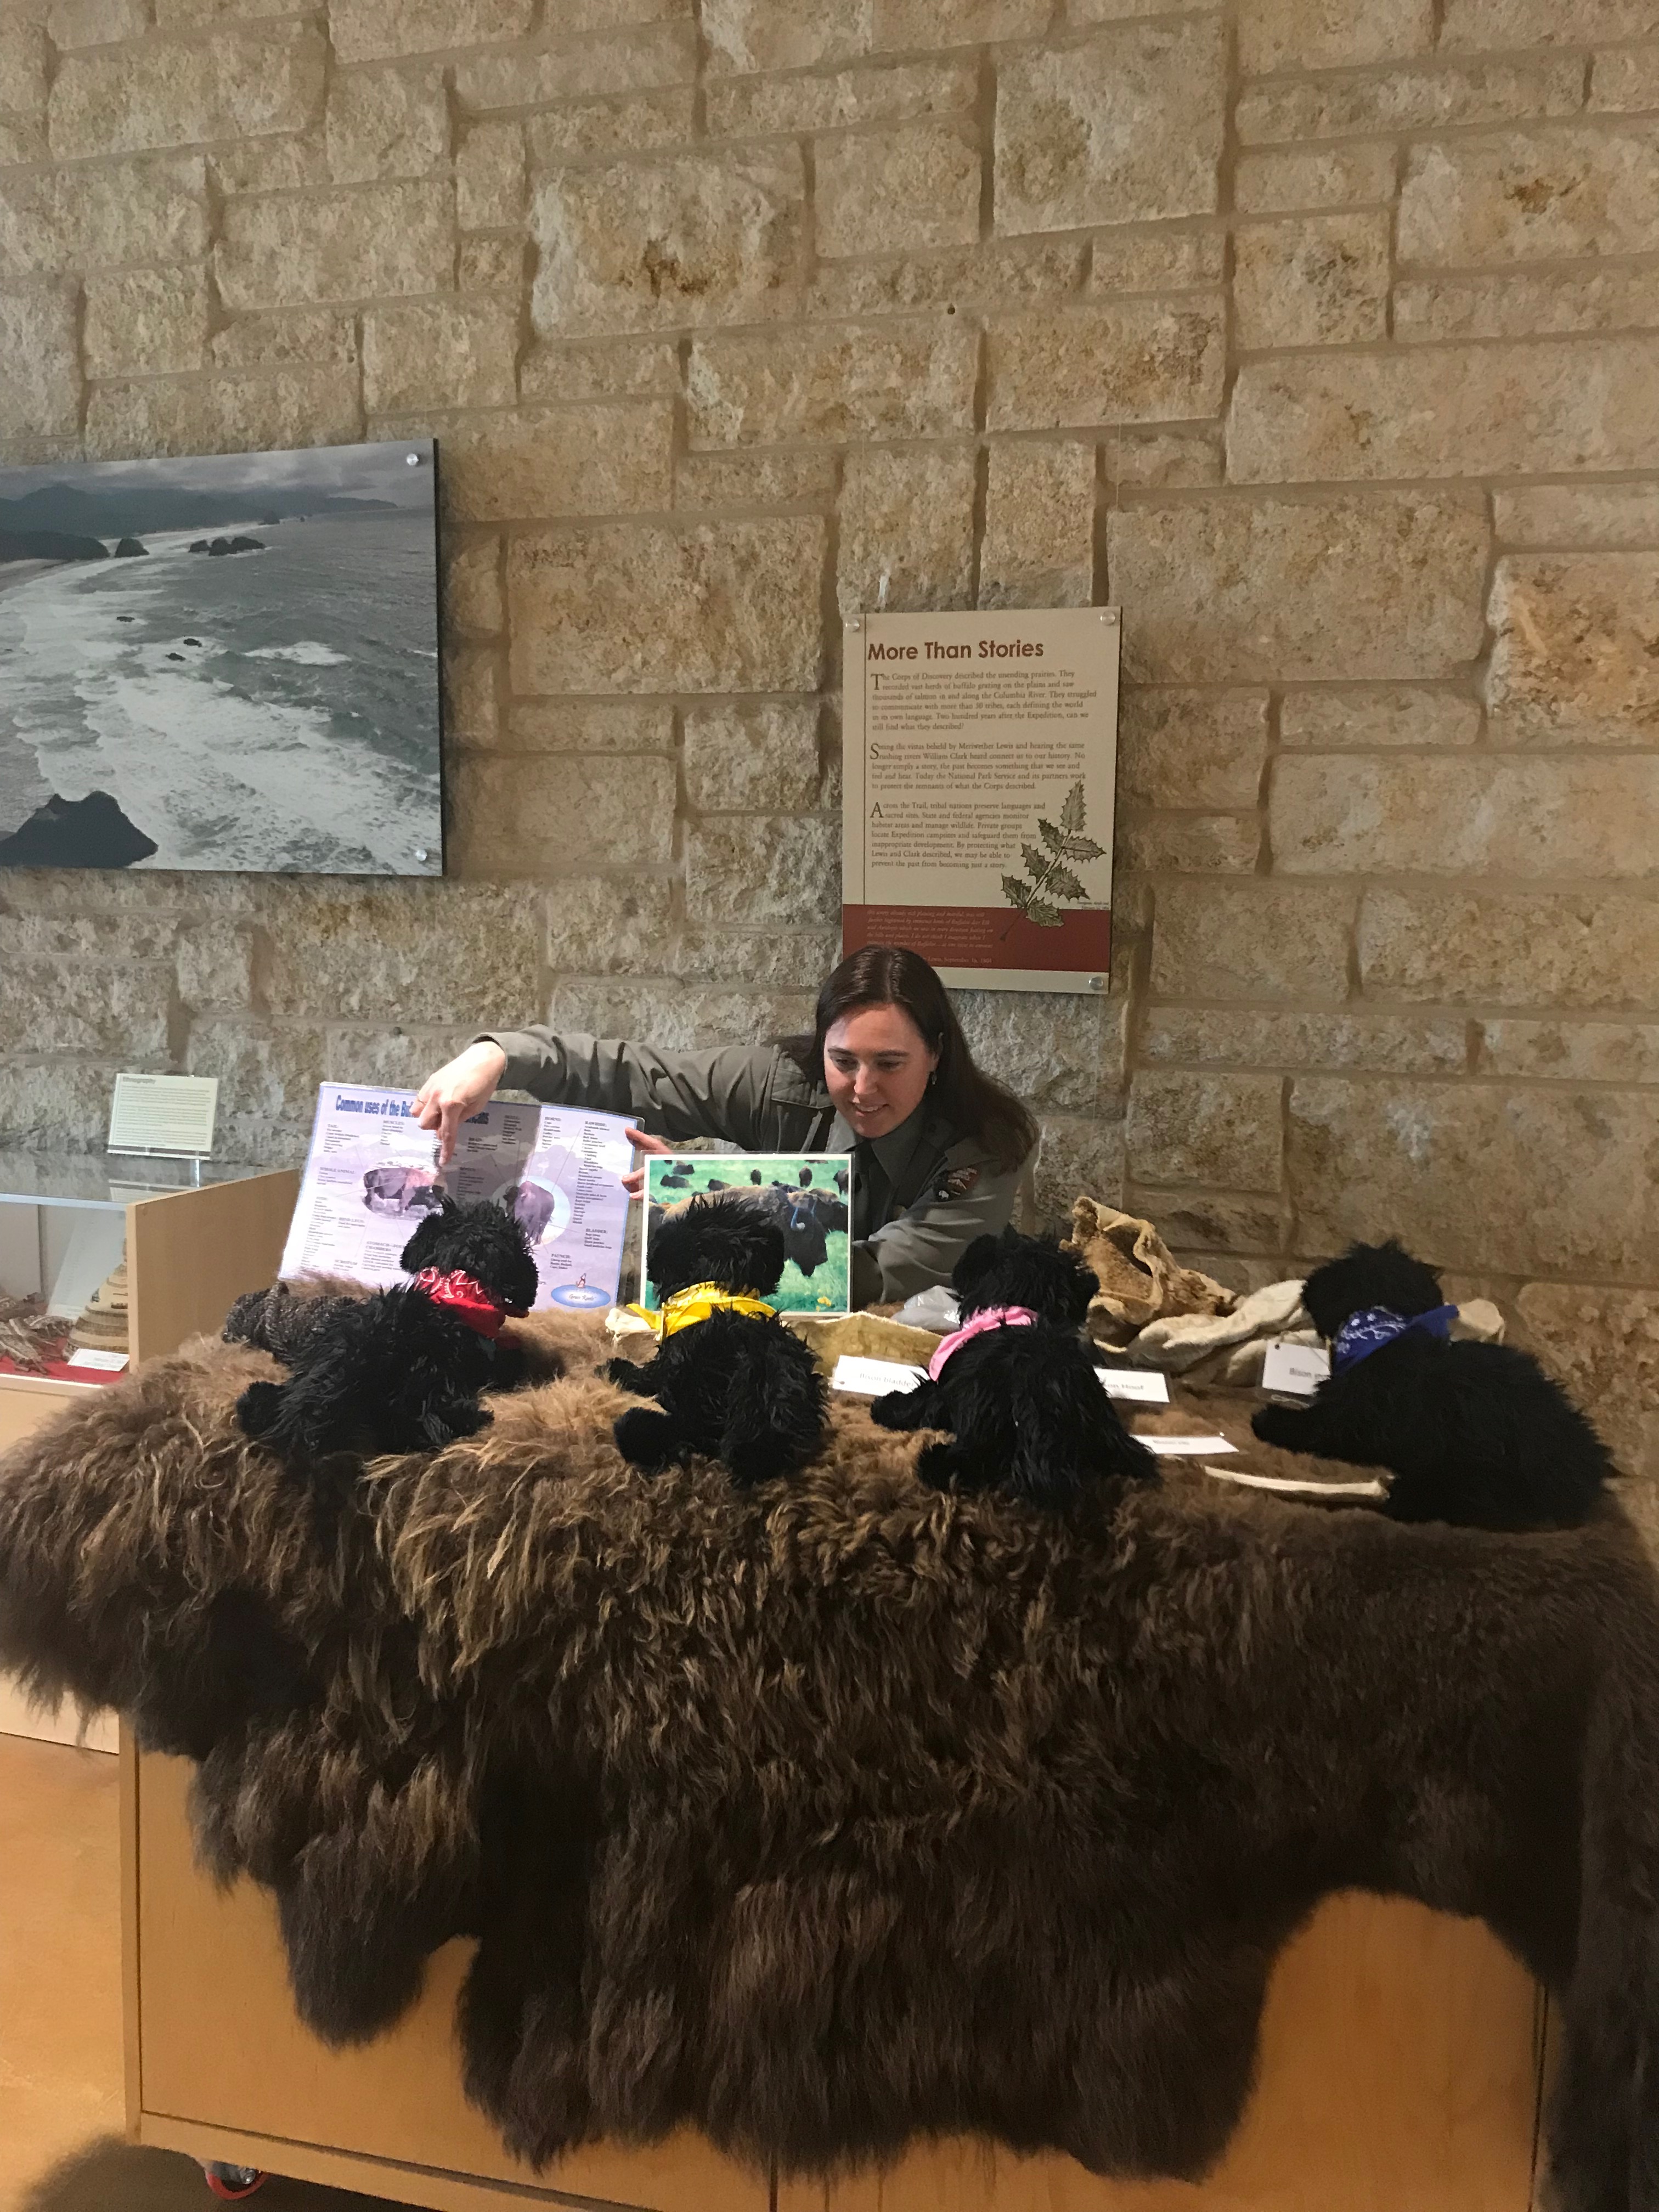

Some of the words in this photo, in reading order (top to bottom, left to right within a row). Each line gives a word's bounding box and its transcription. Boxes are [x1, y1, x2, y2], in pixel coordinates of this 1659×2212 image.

[868, 643, 918, 660] More
[924, 641, 971, 659] Than
[978, 640, 1043, 658] Stories
[891, 673, 911, 681] Corps
[922, 673, 952, 681] Discovery
[998, 672, 1029, 680] unending
[1059, 670, 1074, 679] They
[1026, 681, 1046, 690] plains
[962, 692, 979, 701] along
[1049, 691, 1065, 699] They
[1067, 691, 1097, 699] struggled
[1022, 702, 1049, 710] defining
[917, 723, 930, 731] they
[949, 743, 956, 751] by
[1030, 742, 1053, 751] hearing
[872, 763, 891, 771] longer
[995, 763, 1028, 771] something
[916, 773, 933, 781] Today
[1041, 773, 1068, 781] partners
[880, 783, 901, 791] protect
[983, 783, 1003, 791] Corps
[1001, 803, 1031, 811] languages
[891, 831, 924, 839] Expedition
[926, 832, 956, 840] campsites
[972, 832, 1000, 840] safeguard
[956, 842, 964, 850] By
[967, 842, 998, 850] protecting
[907, 861, 919, 869] past
[939, 861, 969, 870] becoming
[336, 1095, 364, 1113] Common
[364, 1102, 380, 1114] uses
[381, 1099, 389, 1115] of
[389, 1100, 400, 1116] the
